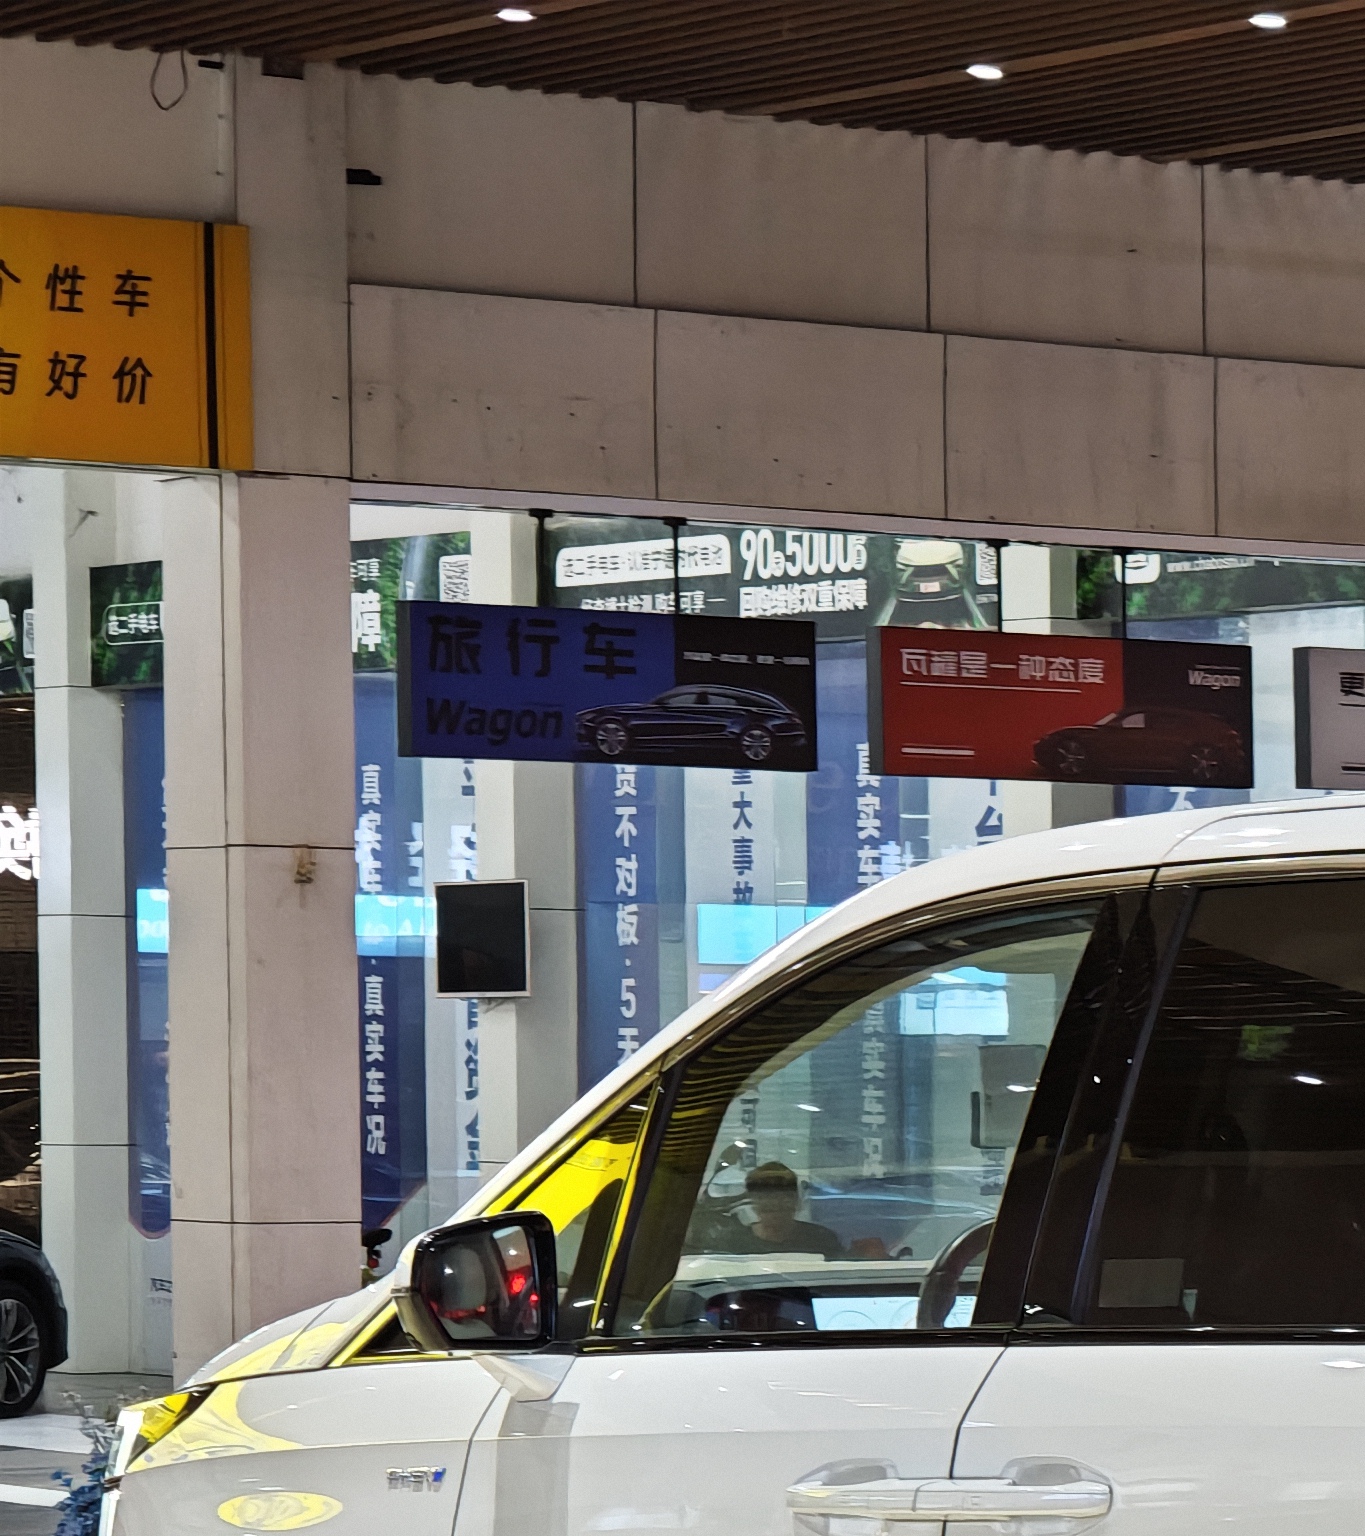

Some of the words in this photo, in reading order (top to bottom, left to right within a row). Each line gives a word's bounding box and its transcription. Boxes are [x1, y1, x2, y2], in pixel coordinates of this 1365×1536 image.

[426, 613, 638, 680] 旅行车
[425, 696, 563, 746] Wagon
